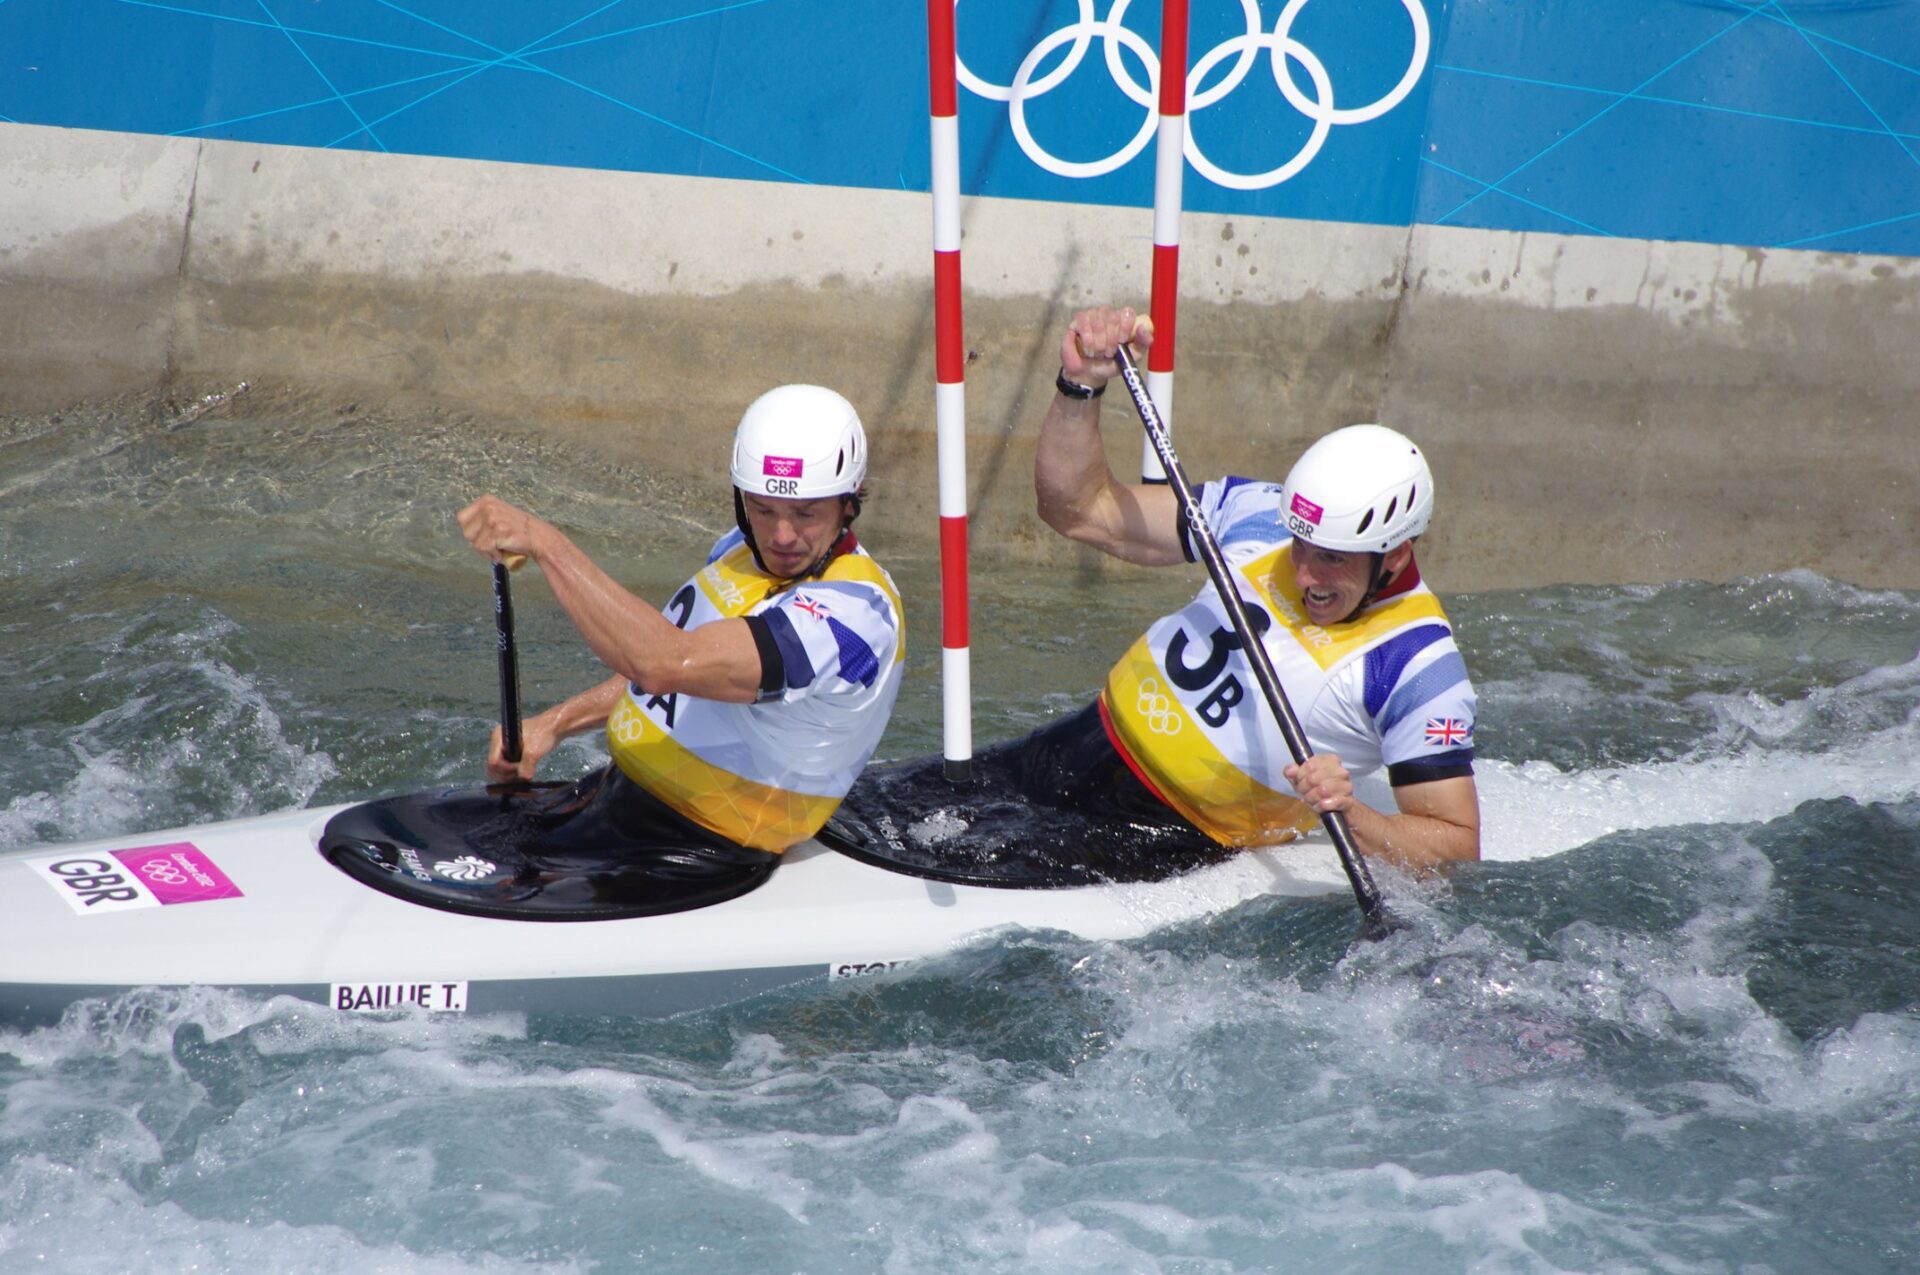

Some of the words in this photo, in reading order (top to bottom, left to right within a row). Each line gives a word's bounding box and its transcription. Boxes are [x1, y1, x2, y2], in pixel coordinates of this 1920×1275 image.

[1123, 367, 1158, 426] London
[1151, 429, 1178, 464] 2012
[765, 478, 799, 496] GBR
[1288, 515, 1313, 540] GBR
[49, 859, 139, 907] GBR
[442, 984, 461, 1009] T.
